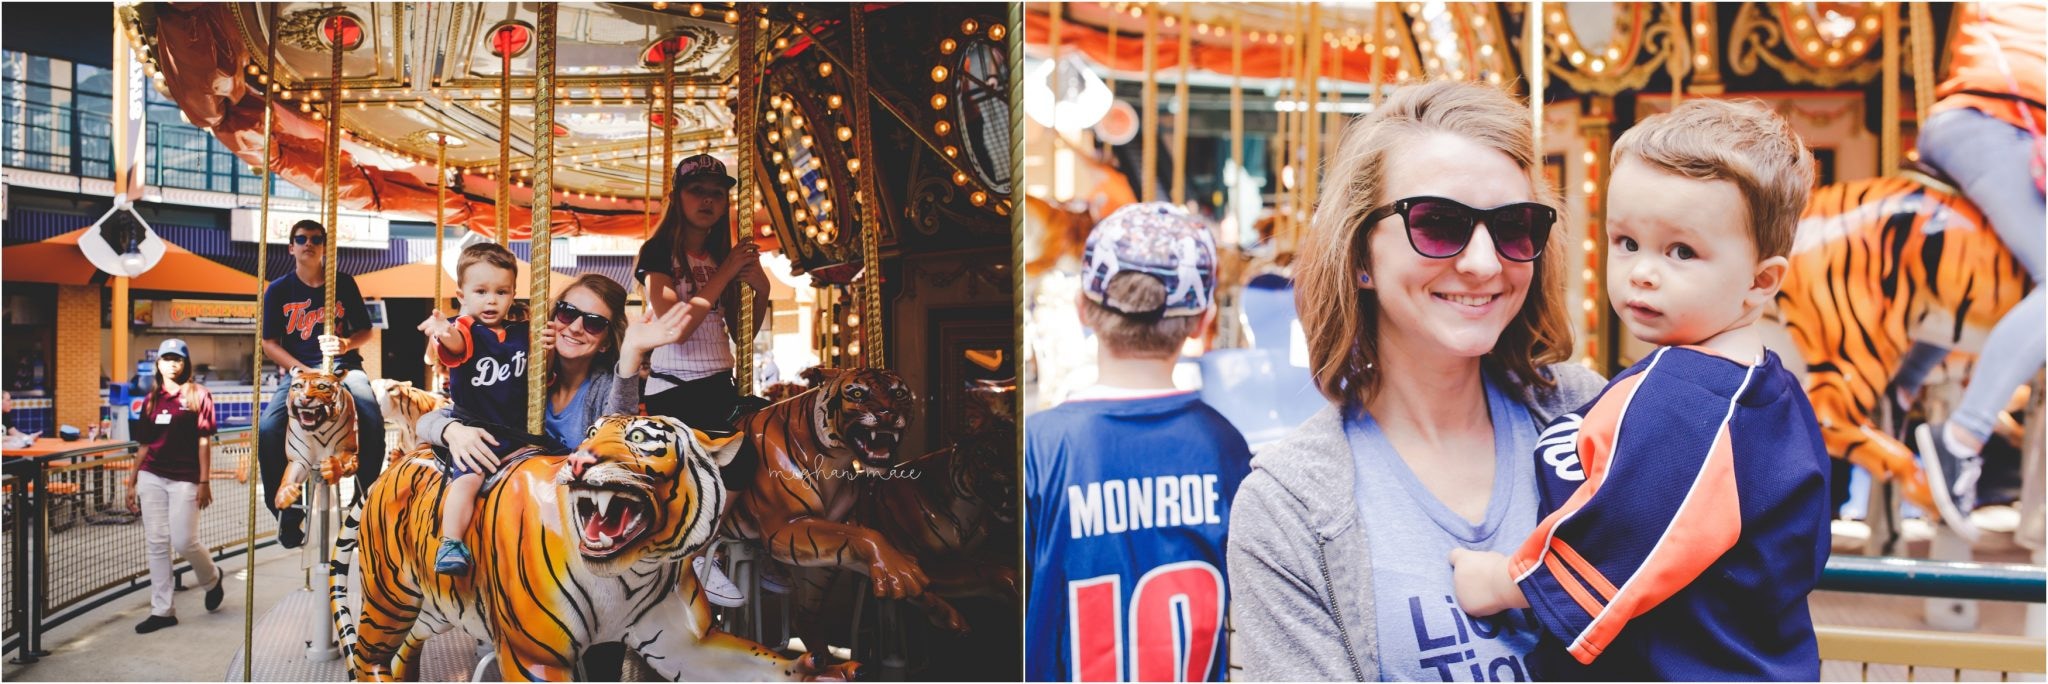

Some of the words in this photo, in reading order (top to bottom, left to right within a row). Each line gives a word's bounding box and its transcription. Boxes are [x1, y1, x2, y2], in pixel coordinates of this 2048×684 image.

[283, 299, 345, 340] Tiges
[1068, 474, 1221, 539] MONROE
[1068, 560, 1226, 682] 10
